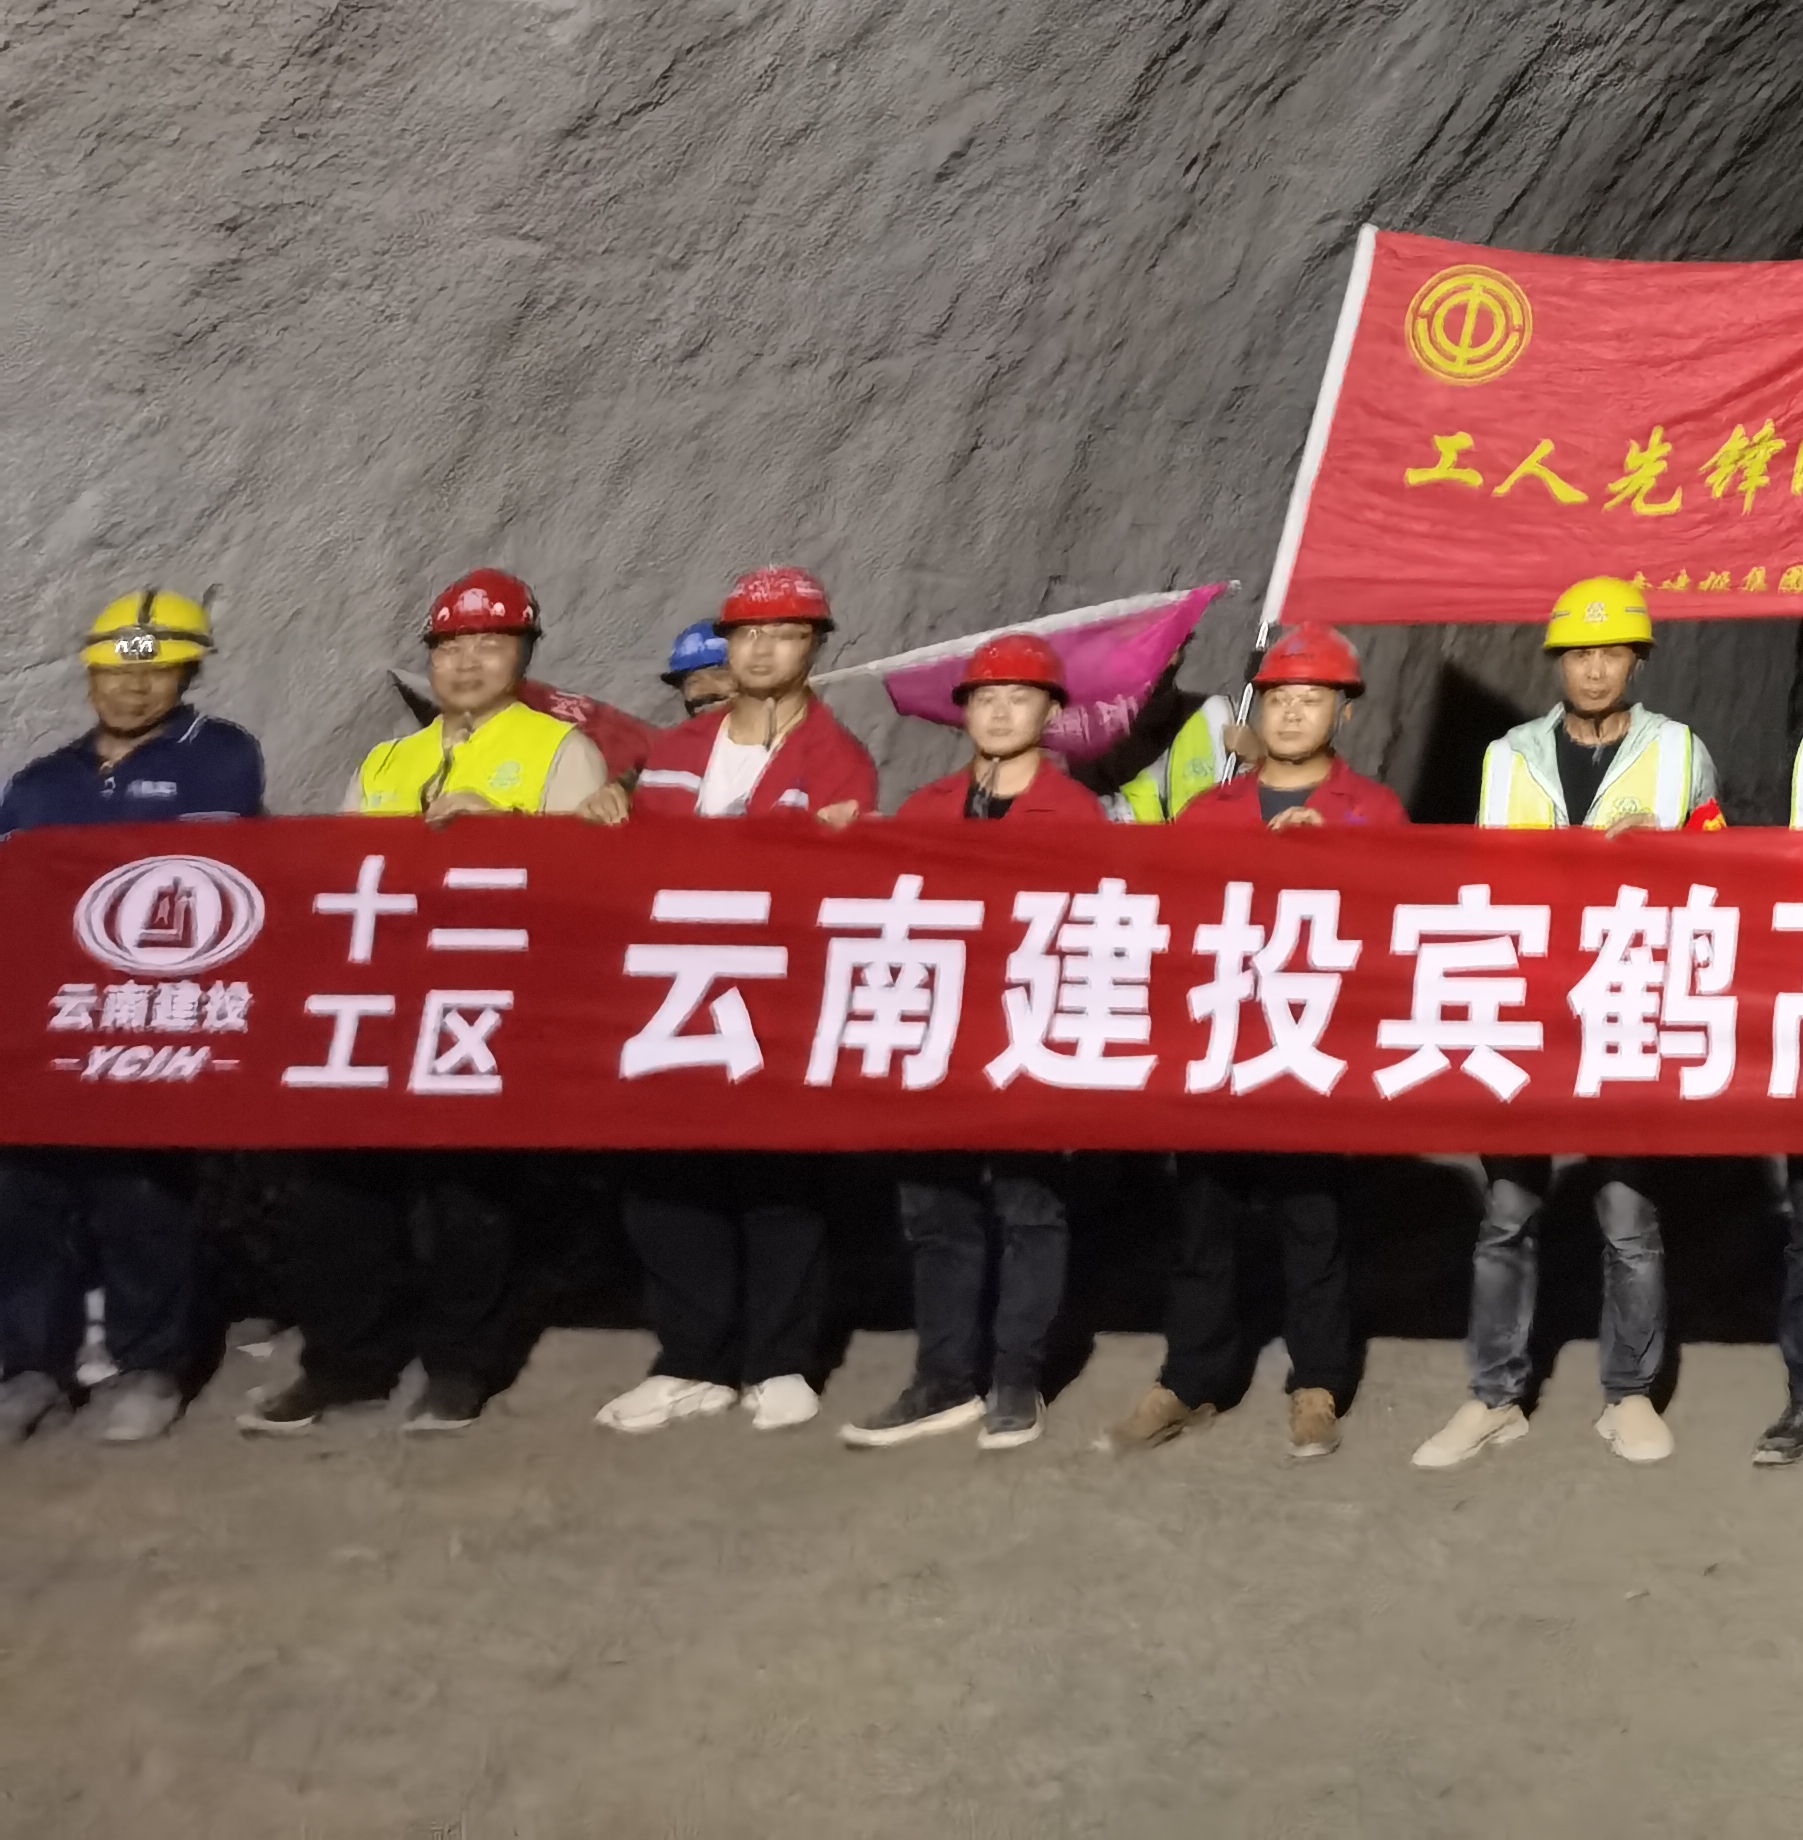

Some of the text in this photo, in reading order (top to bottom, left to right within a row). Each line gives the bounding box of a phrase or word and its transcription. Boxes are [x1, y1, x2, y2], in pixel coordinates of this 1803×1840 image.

[314, 855, 530, 963] 十二
[49, 980, 253, 1033] 云南建投
[281, 989, 515, 1095] 工区
[81, 1045, 211, 1081] YCIH
